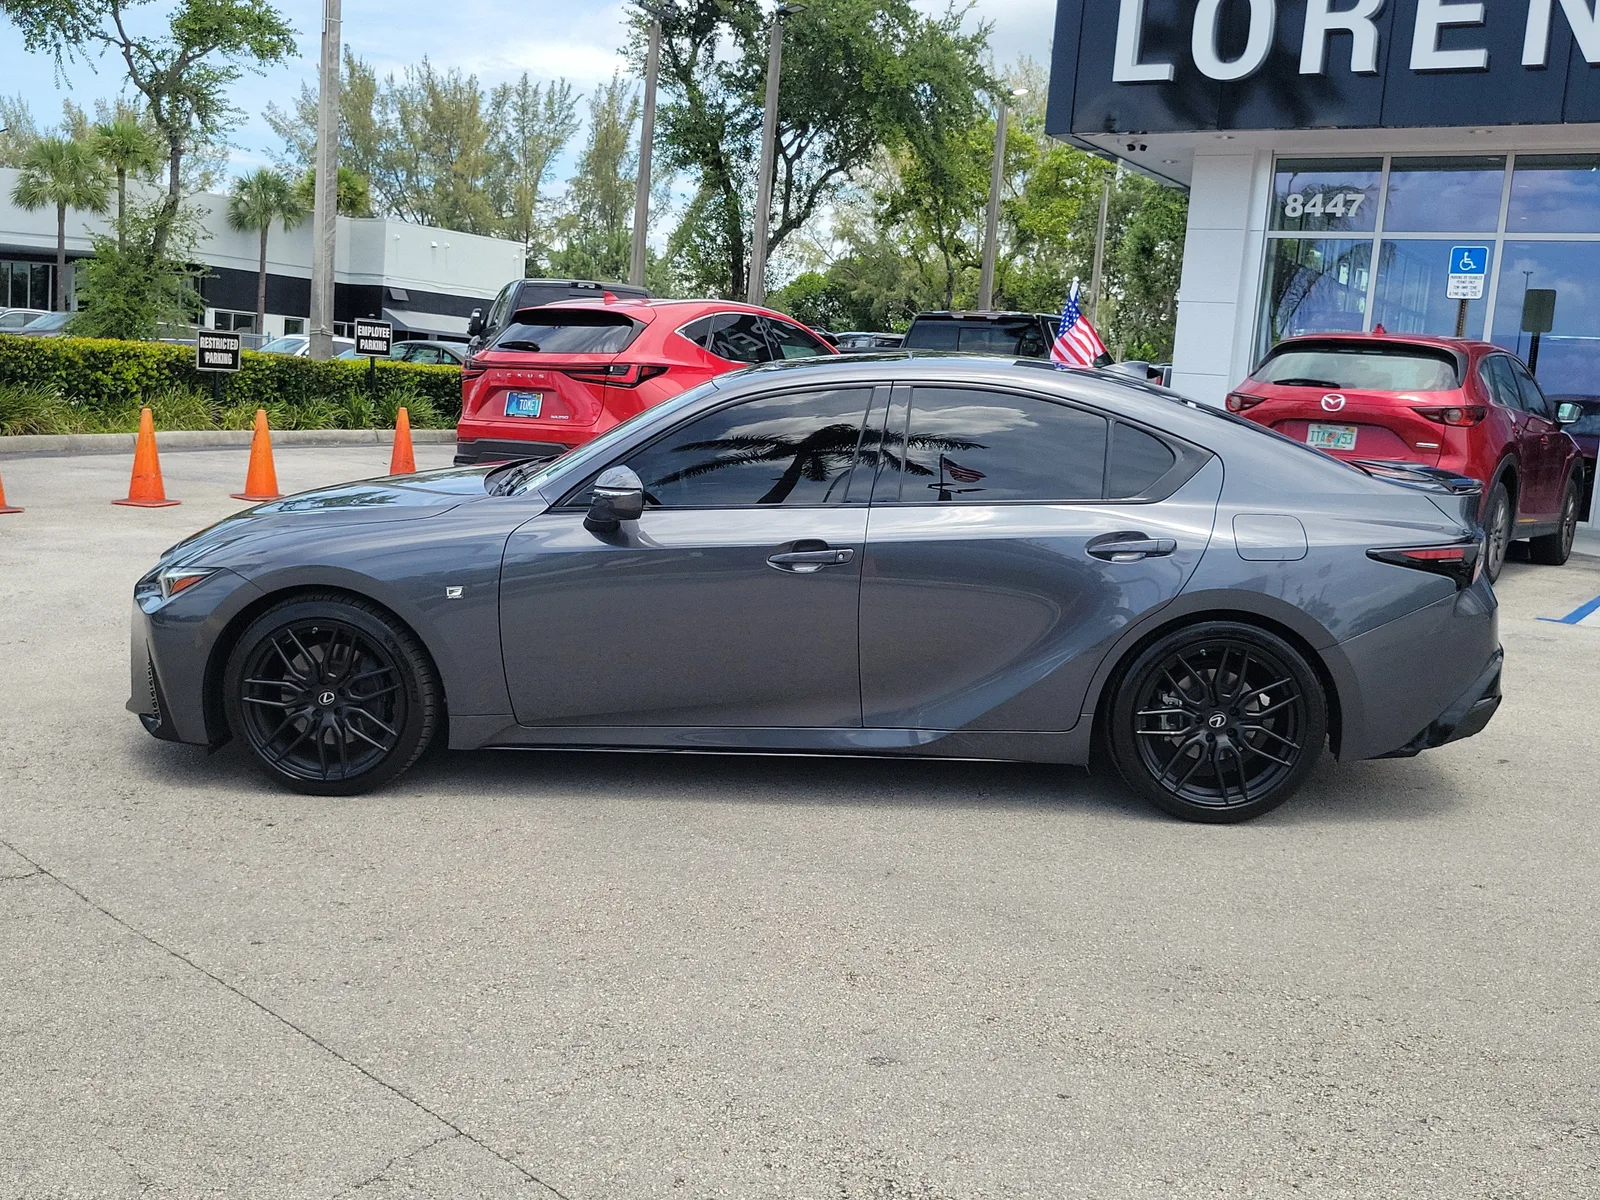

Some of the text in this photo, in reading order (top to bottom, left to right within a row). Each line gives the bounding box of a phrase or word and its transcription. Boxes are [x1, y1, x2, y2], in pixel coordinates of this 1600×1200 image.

[1284, 193, 1366, 218] 8447
[357, 325, 390, 338] EMPLOYEE
[199, 336, 239, 350] RESTRICTED
[359, 339, 387, 351] PARKING
[204, 352, 233, 365] PARKING
